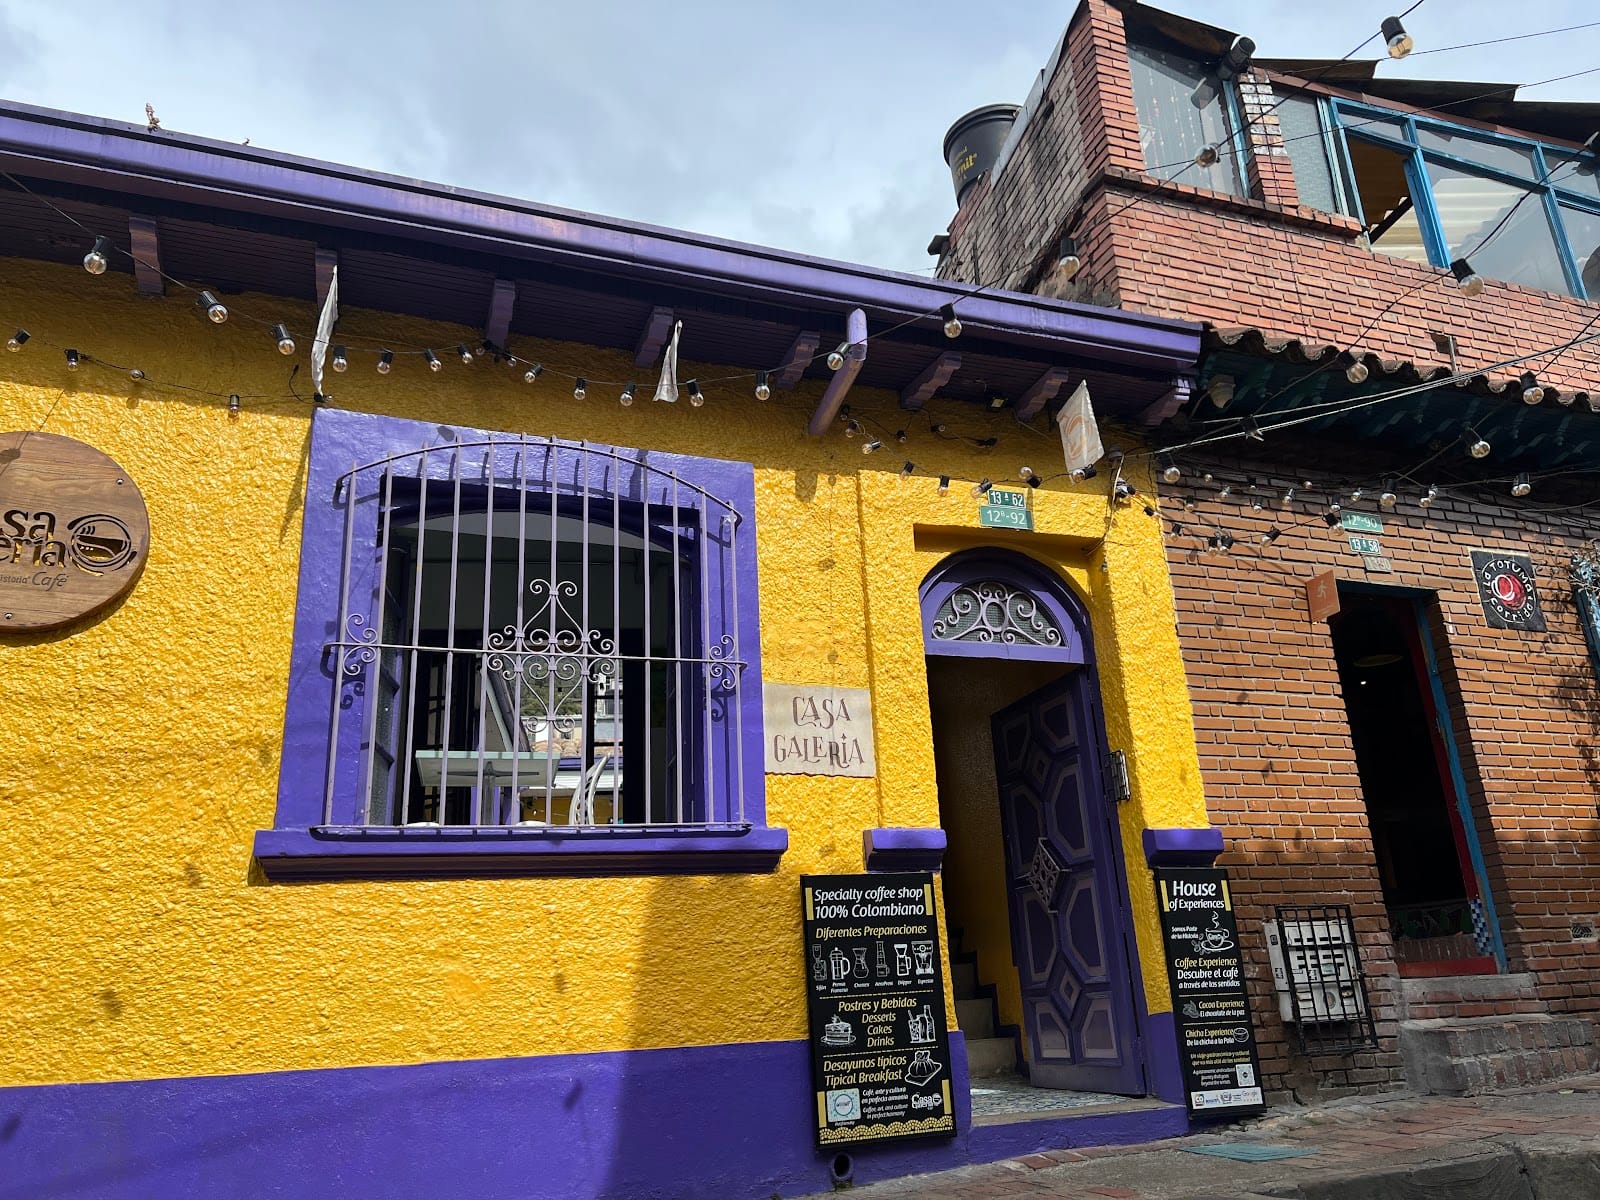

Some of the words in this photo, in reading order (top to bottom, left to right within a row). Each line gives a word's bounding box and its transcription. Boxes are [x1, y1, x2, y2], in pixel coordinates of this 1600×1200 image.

[32, 572, 70, 592] Café
[792, 696, 851, 729] CASA
[814, 888, 862, 904] Specialty
[865, 886, 896, 902] coffee
[898, 887, 922, 901] shop
[1173, 880, 1216, 896] House
[815, 904, 848, 919] 100%
[852, 903, 924, 918] Colombiano
[1170, 898, 1178, 912] of
[1179, 899, 1224, 912] Experiences
[816, 927, 862, 941] Diferentes
[864, 924, 927, 938] Preparaciones
[1174, 957, 1198, 970] Coffee
[1199, 958, 1237, 968] Experience
[1178, 969, 1212, 980] Descubre
[1214, 968, 1222, 978] el
[1222, 968, 1238, 980] café
[1202, 980, 1208, 988] de
[838, 1000, 872, 1012] Postres
[874, 1002, 880, 1012] y
[881, 998, 917, 1009] Bebidas
[1216, 1000, 1244, 1010] Experience
[862, 1012, 896, 1024] Desserts
[867, 1024, 892, 1036] Cakes
[1204, 1028, 1234, 1038] Experience
[867, 1036, 894, 1047] Drinks
[824, 1058, 876, 1074] Desayunos
[825, 1074, 856, 1088] Tipical
[858, 1068, 903, 1084] Breakfast
[912, 1094, 932, 1104] Casa
